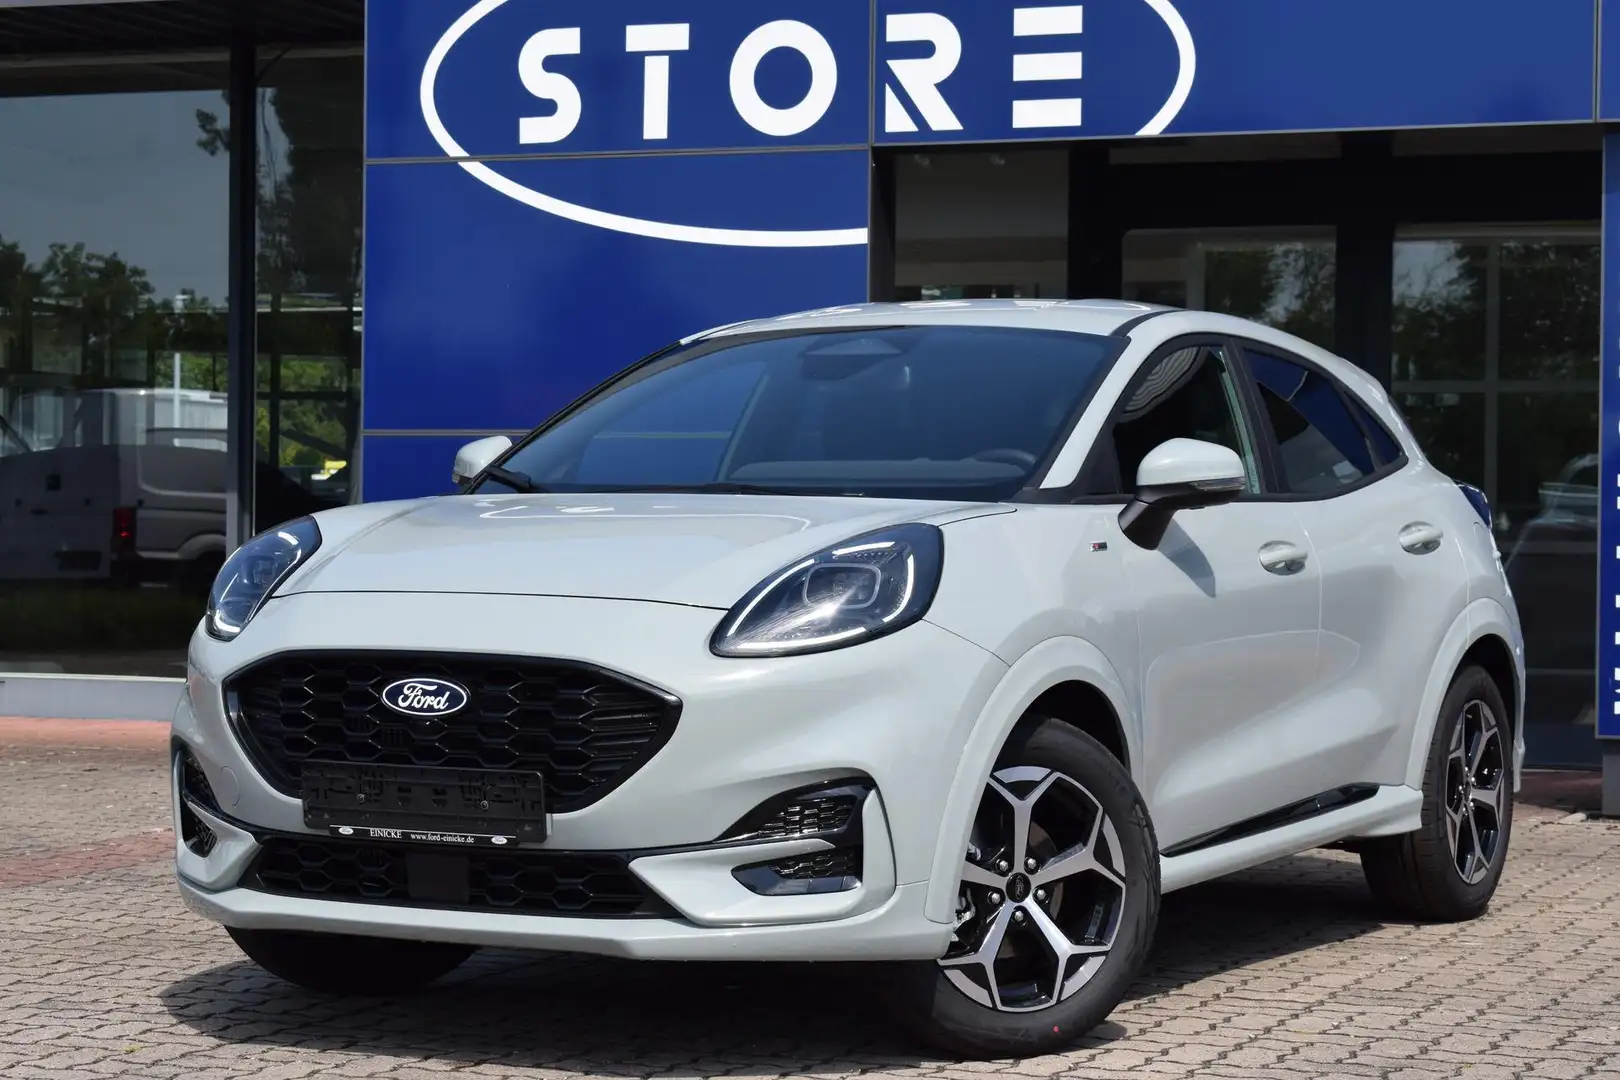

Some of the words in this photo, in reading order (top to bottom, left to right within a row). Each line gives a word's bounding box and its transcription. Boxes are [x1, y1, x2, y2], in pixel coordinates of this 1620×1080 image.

[518, 5, 1083, 144] STORE
[398, 682, 451, 710] Ford
[370, 829, 402, 839] EINICKE
[409, 833, 475, 843] www.ford-einicke.de
